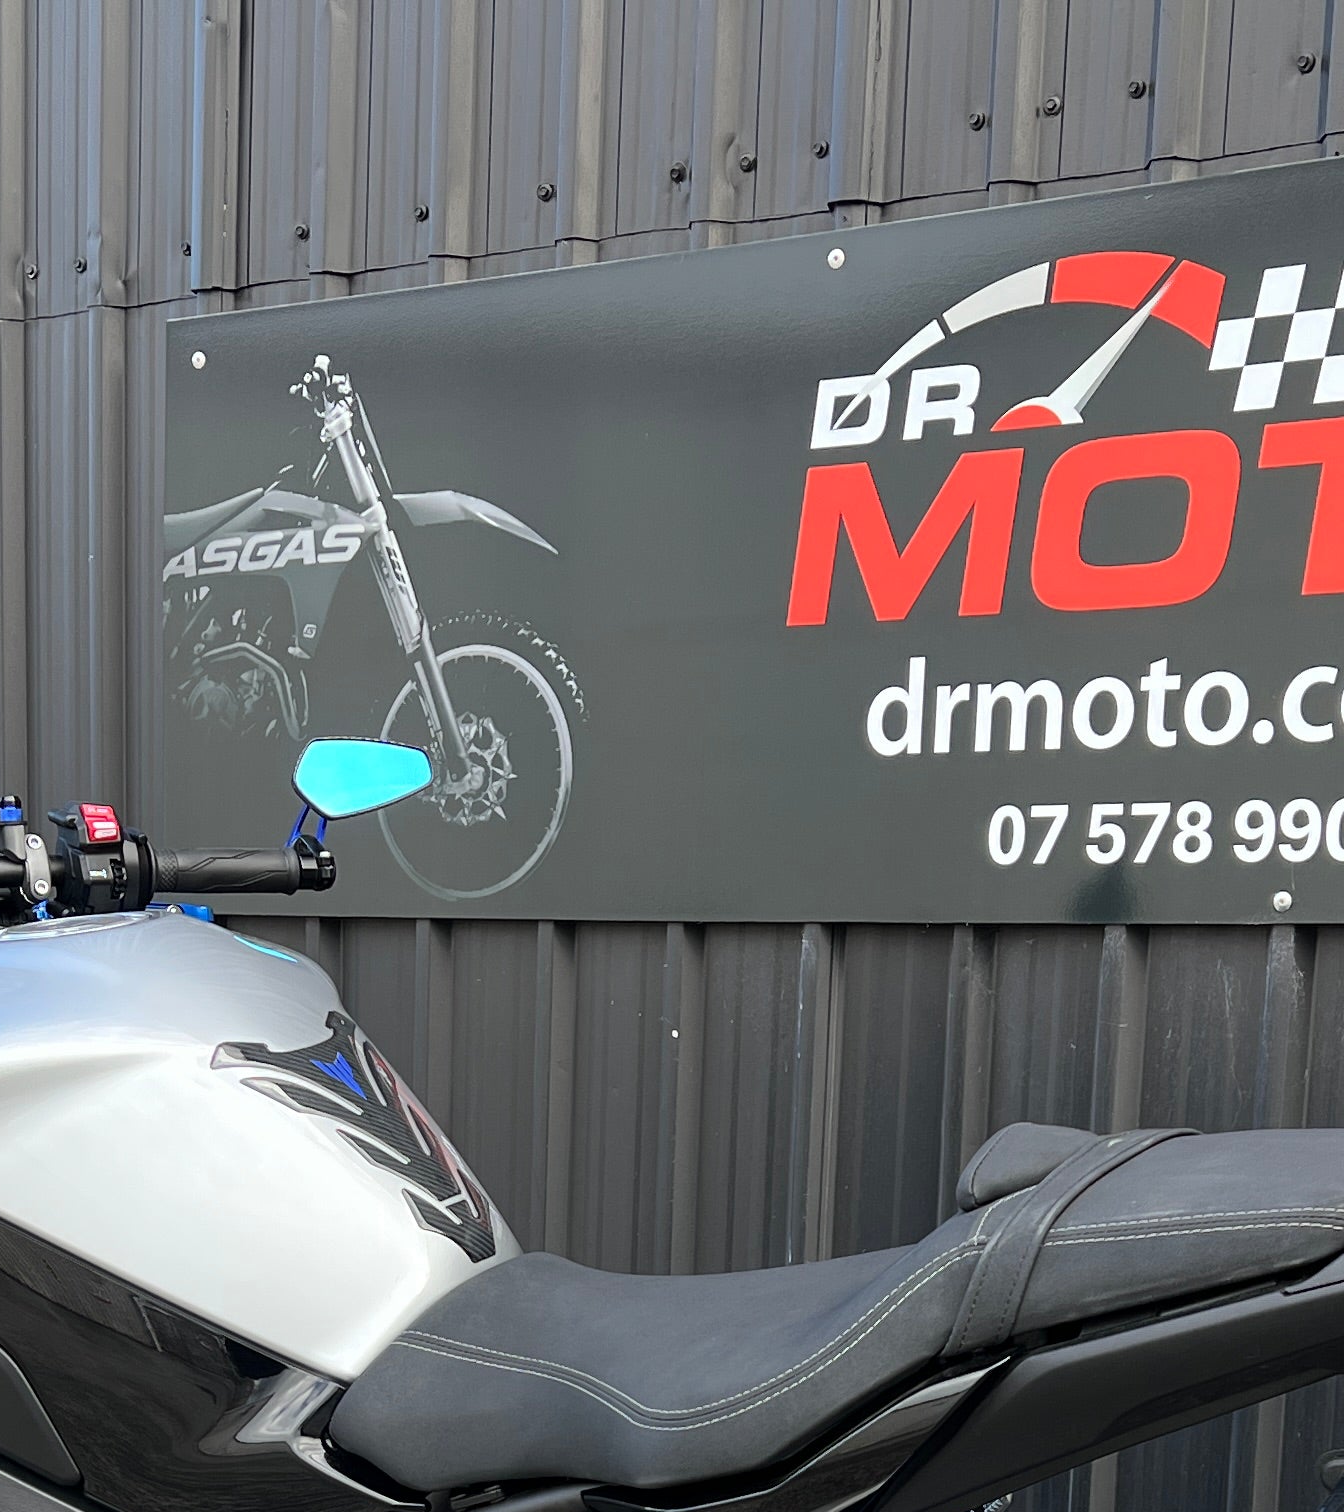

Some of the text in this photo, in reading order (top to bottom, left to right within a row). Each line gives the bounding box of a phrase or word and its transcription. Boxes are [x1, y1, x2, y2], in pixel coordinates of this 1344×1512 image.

[810, 363, 981, 450] DR
[987, 803, 1070, 866] 07
[1086, 800, 1213, 865] 578
